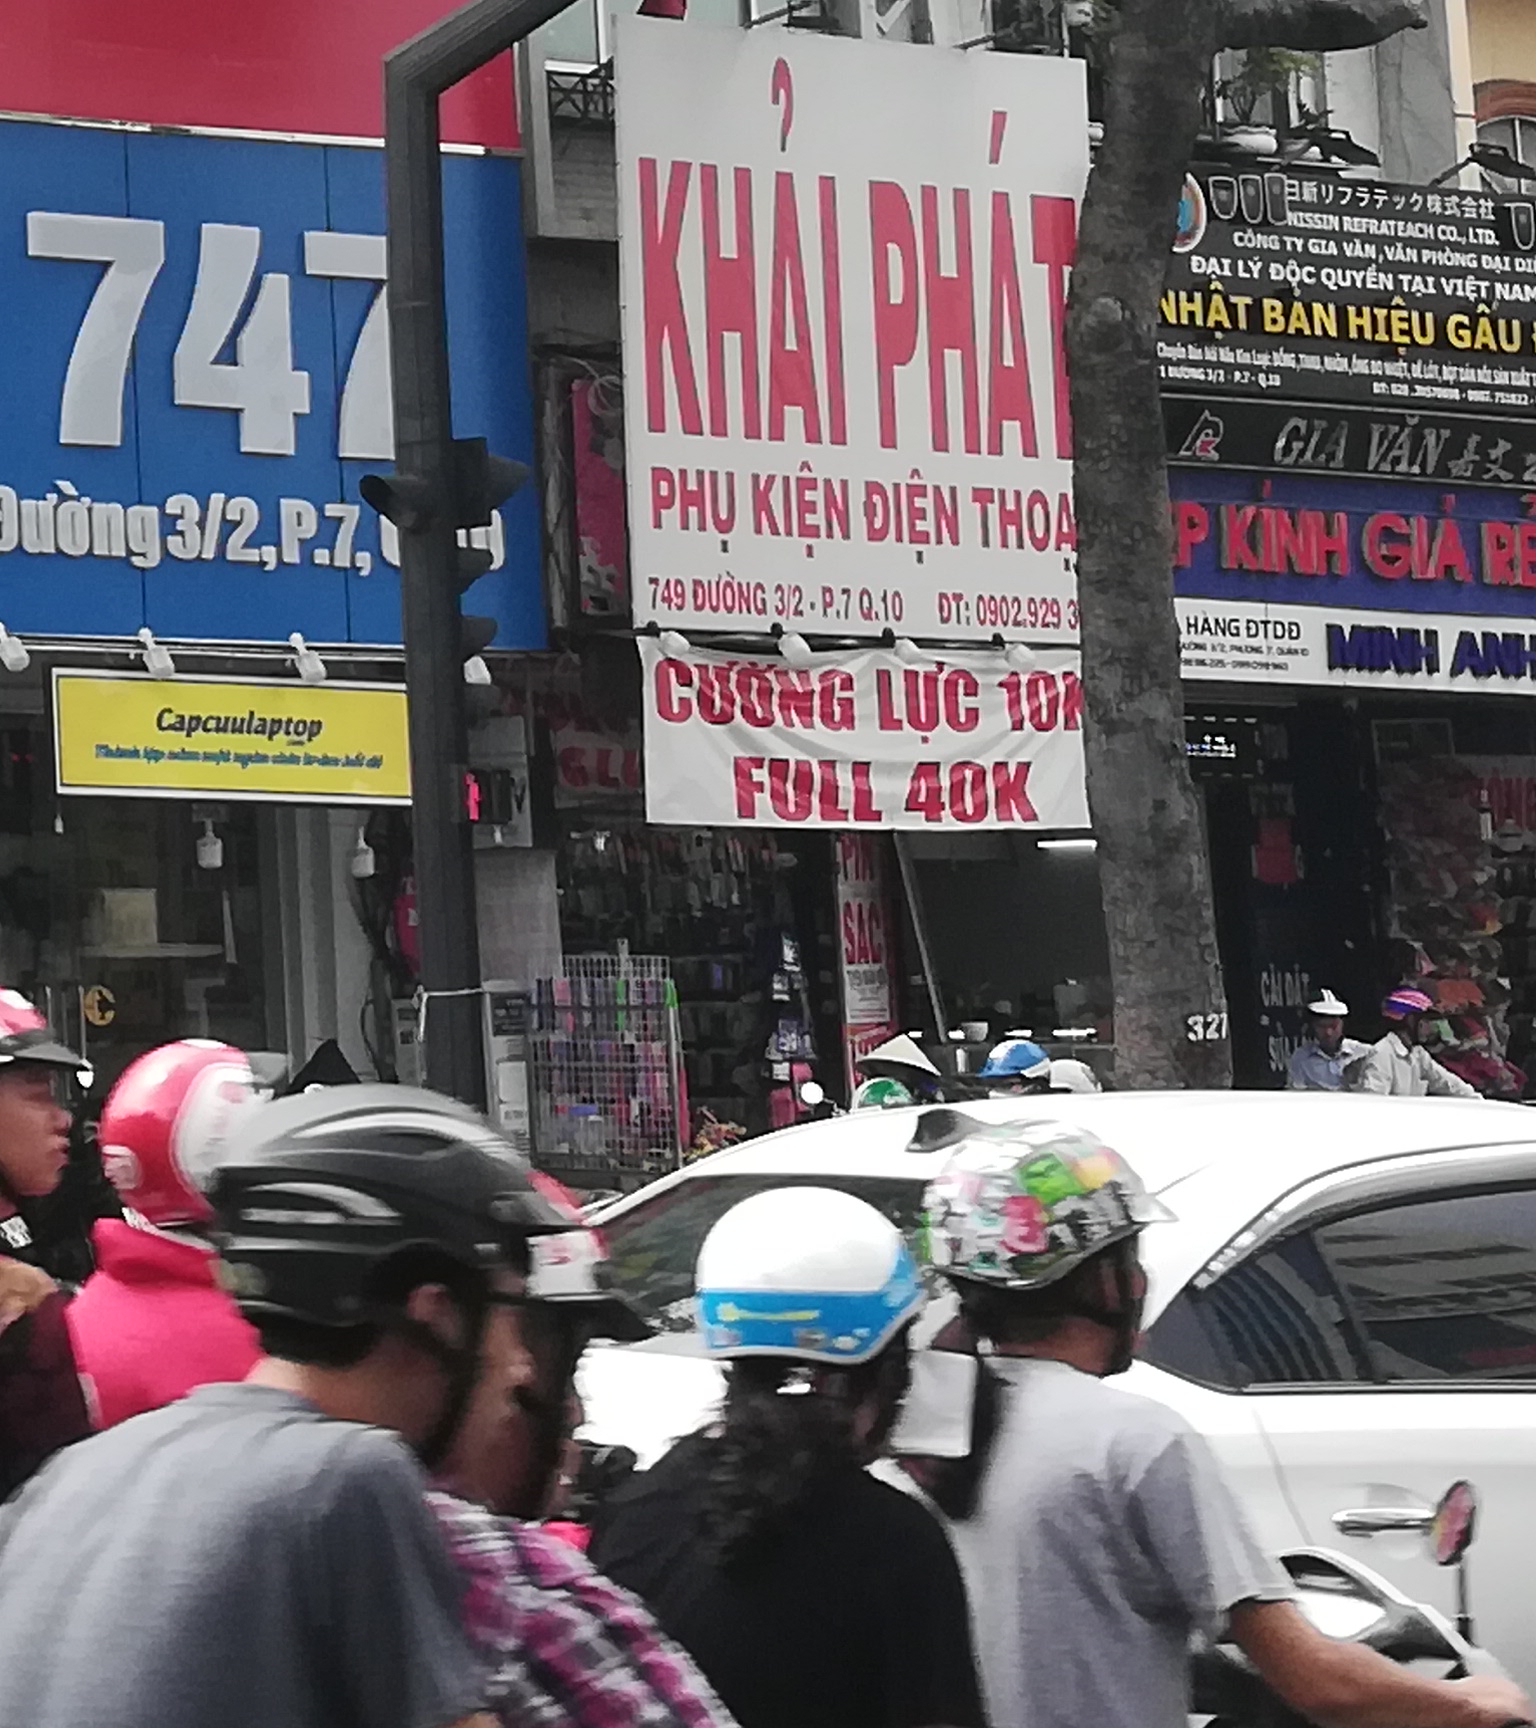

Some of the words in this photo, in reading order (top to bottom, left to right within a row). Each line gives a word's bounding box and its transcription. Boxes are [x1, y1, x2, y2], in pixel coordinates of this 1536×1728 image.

[638, 56, 850, 446] KHẢI
[1283, 236, 1304, 254] TY
[1307, 238, 1338, 257] GIA
[1287, 210, 1340, 232] NISSIN
[1190, 255, 1232, 281] ĐẠI
[1237, 251, 1261, 279] LÝ
[1397, 273, 1436, 298] TẠI
[1440, 276, 1491, 303] VIỆT
[25, 210, 396, 461] 747
[1160, 279, 1253, 341] NHẬT
[1347, 295, 1437, 356] HIỆU
[1273, 416, 1349, 469] GIA
[1366, 412, 1452, 475] VĂN
[650, 465, 737, 554] PHỤ
[751, 460, 853, 559] KIỆN
[863, 468, 961, 564] ĐIỆN
[971, 486, 1079, 572] THOẠ
[1220, 479, 1350, 577] KÍNH
[648, 577, 686, 611] 749
[692, 570, 768, 617] ĐƯỜNG
[774, 582, 805, 621] 3/2
[1186, 610, 1240, 638] HÀNG
[1325, 622, 1441, 676] MINH
[1449, 630, 1536, 681] ANH
[156, 707, 323, 745] Capcuulaptop
[877, 661, 980, 745] LỰC
[733, 755, 883, 823] FULL
[905, 760, 1040, 824] 40K
